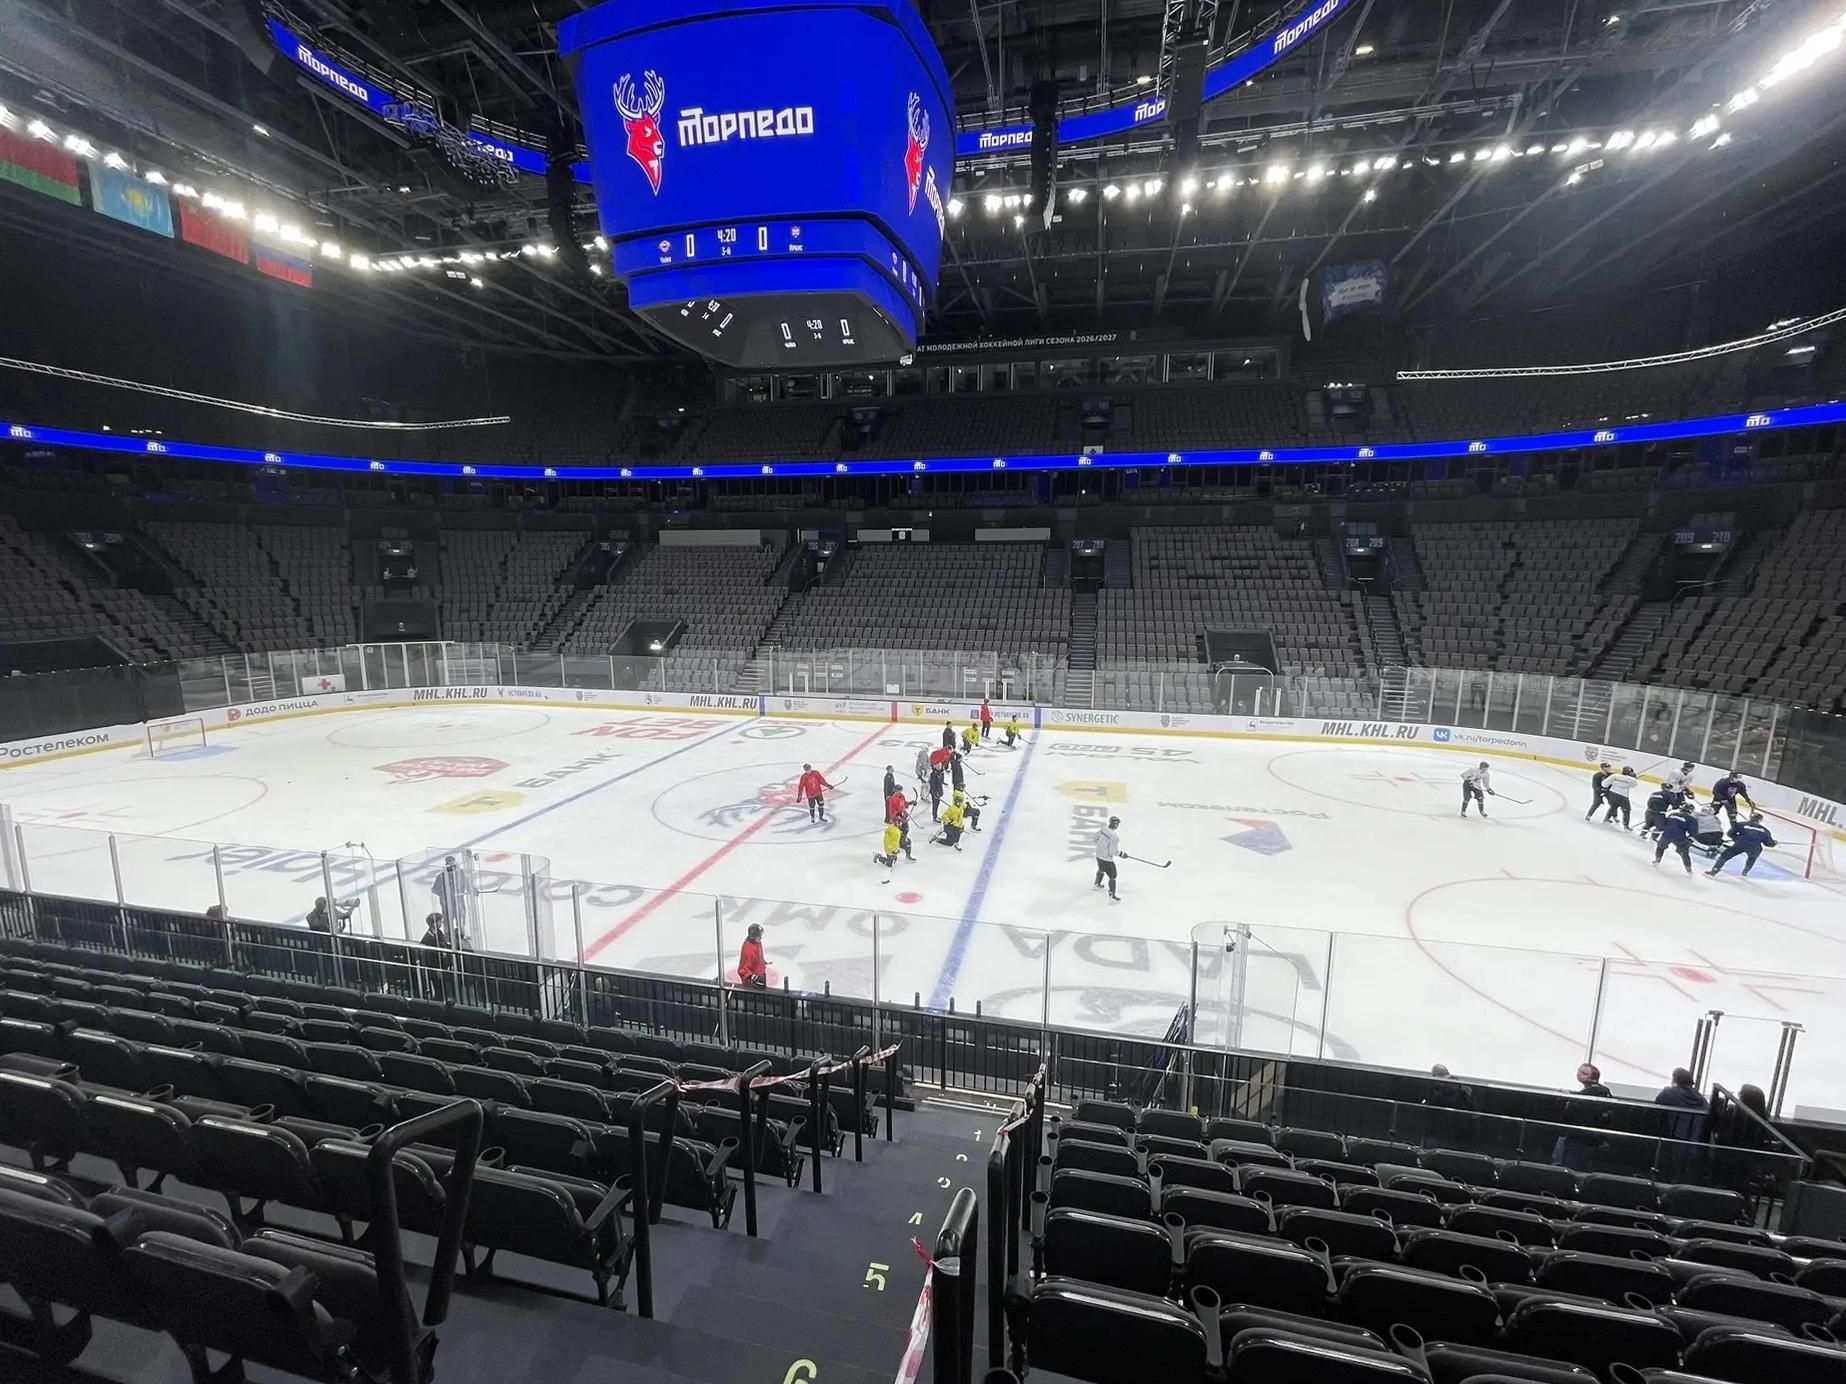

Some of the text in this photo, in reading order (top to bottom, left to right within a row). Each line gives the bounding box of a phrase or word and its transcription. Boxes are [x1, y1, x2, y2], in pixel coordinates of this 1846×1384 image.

[979, 131, 1033, 149] Торпед
[717, 228, 737, 243] 4:20
[758, 226, 768, 251] 0
[686, 233, 695, 258] 0
[780, 322, 792, 340] 0
[839, 319, 851, 337] 0
[979, 338, 1023, 349] ХОККЕЙНОЙ
[1024, 338, 1045, 347] ЛИГИ
[1046, 336, 1075, 345] СЕЗОНА
[1076, 334, 1117, 343] 2026/2027
[1675, 532, 1695, 544] 209
[413, 688, 488, 700] MHL.KHL.RU
[689, 695, 758, 709] MHL.KHL.RU
[1065, 713, 1119, 725] SYNERGETIC
[1321, 721, 1420, 740] MHL.KHL.RU
[1454, 733, 1528, 748] vk.ru/torpedonn
[862, 1262, 890, 1291] 5
